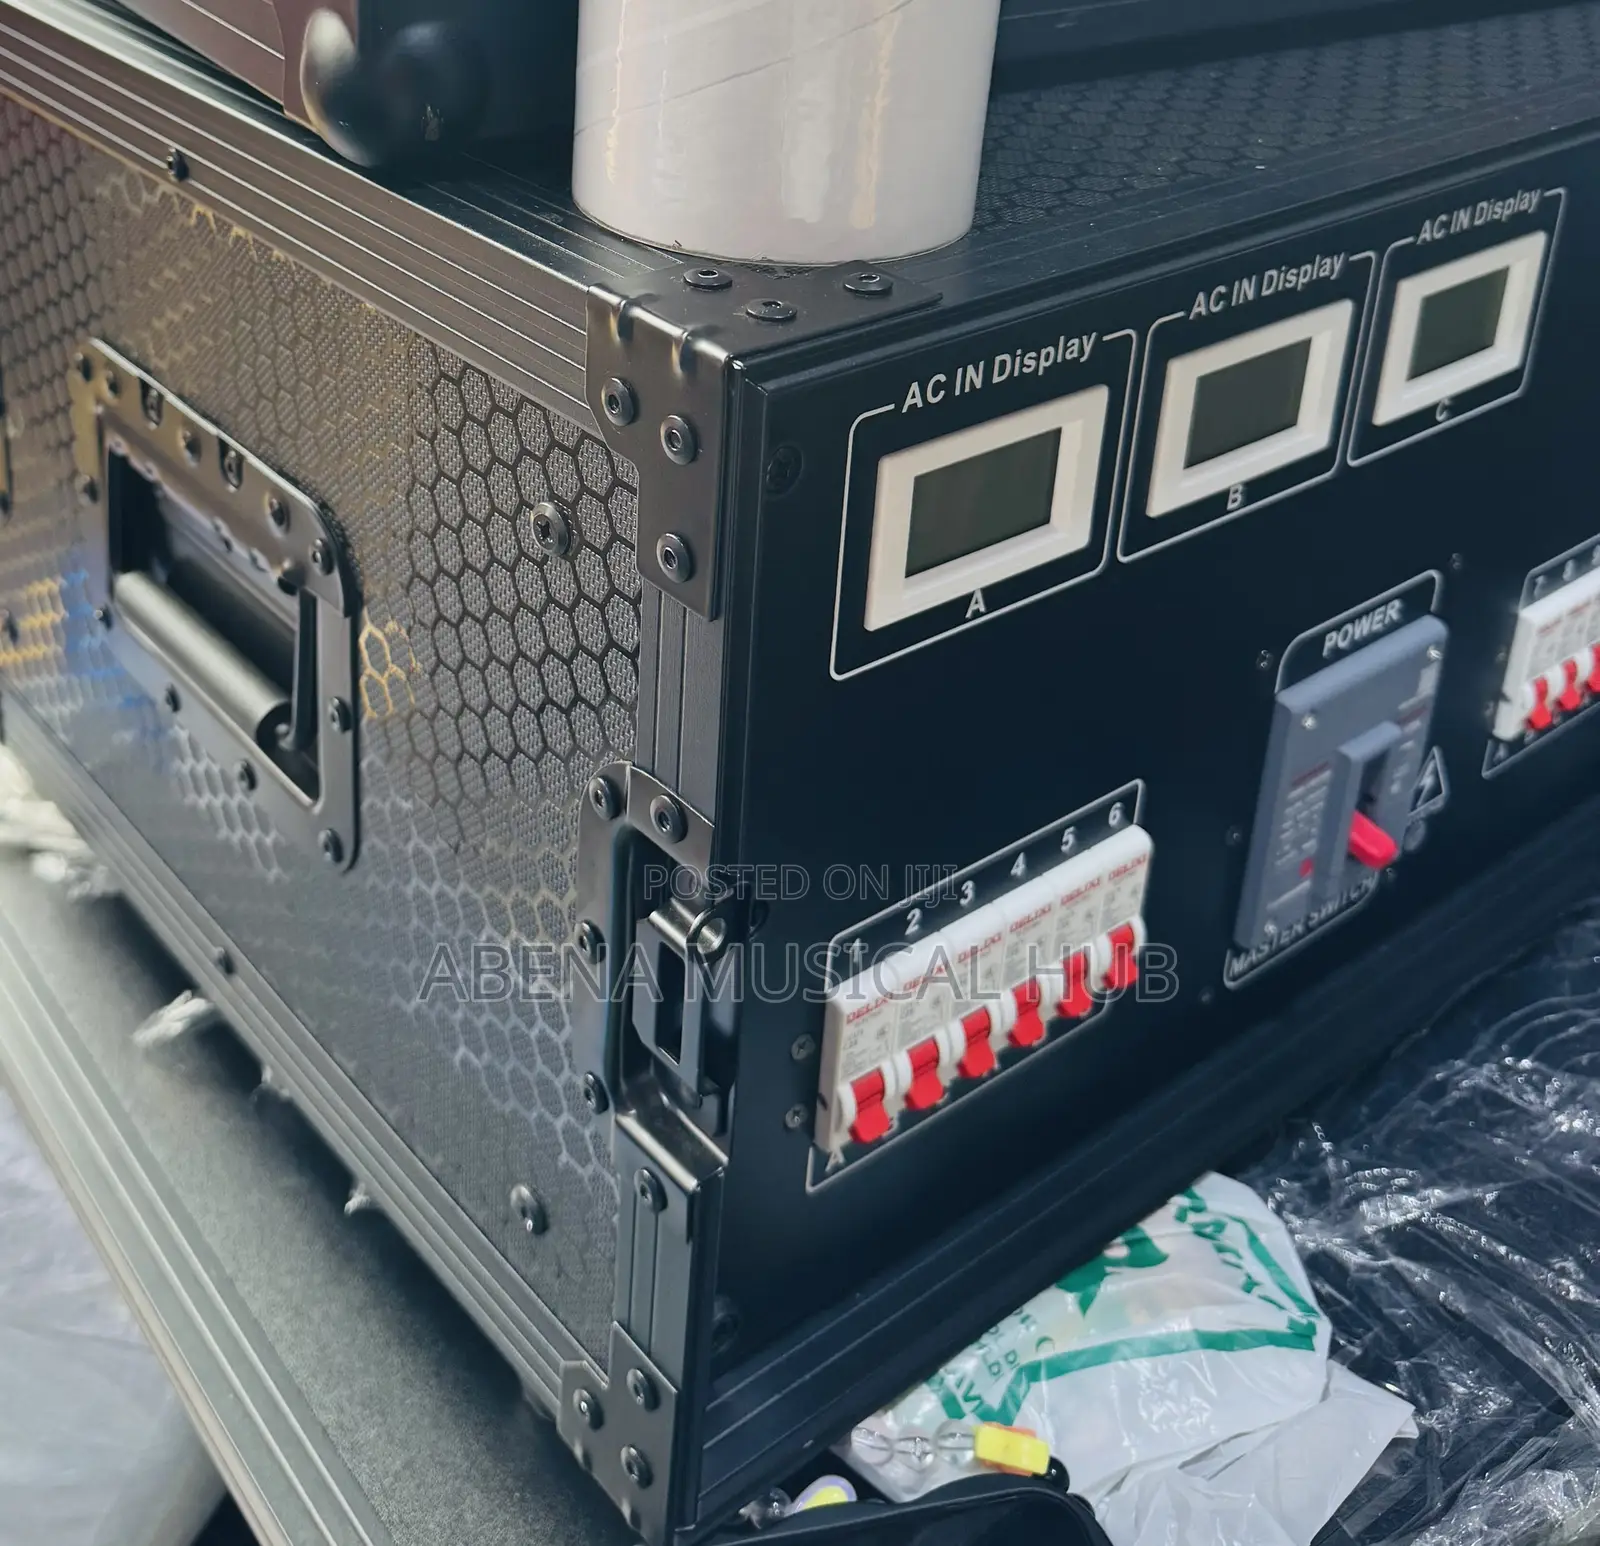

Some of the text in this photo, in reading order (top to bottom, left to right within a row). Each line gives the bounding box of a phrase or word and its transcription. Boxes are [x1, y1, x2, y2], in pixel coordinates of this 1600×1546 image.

[1416, 189, 1541, 244] AC IN Display
[1189, 252, 1346, 320] AC IN Display
[901, 332, 1098, 413] AC IN Display
[1435, 399, 1451, 423] C
[1227, 485, 1244, 510] B
[965, 590, 987, 618] A
[1322, 599, 1402, 658] POWER
[906, 908, 922, 935] 2
[960, 880, 976, 906] 3
[1010, 852, 1026, 877] 4
[1061, 826, 1078, 851] 5
[1109, 802, 1125, 826] 6
